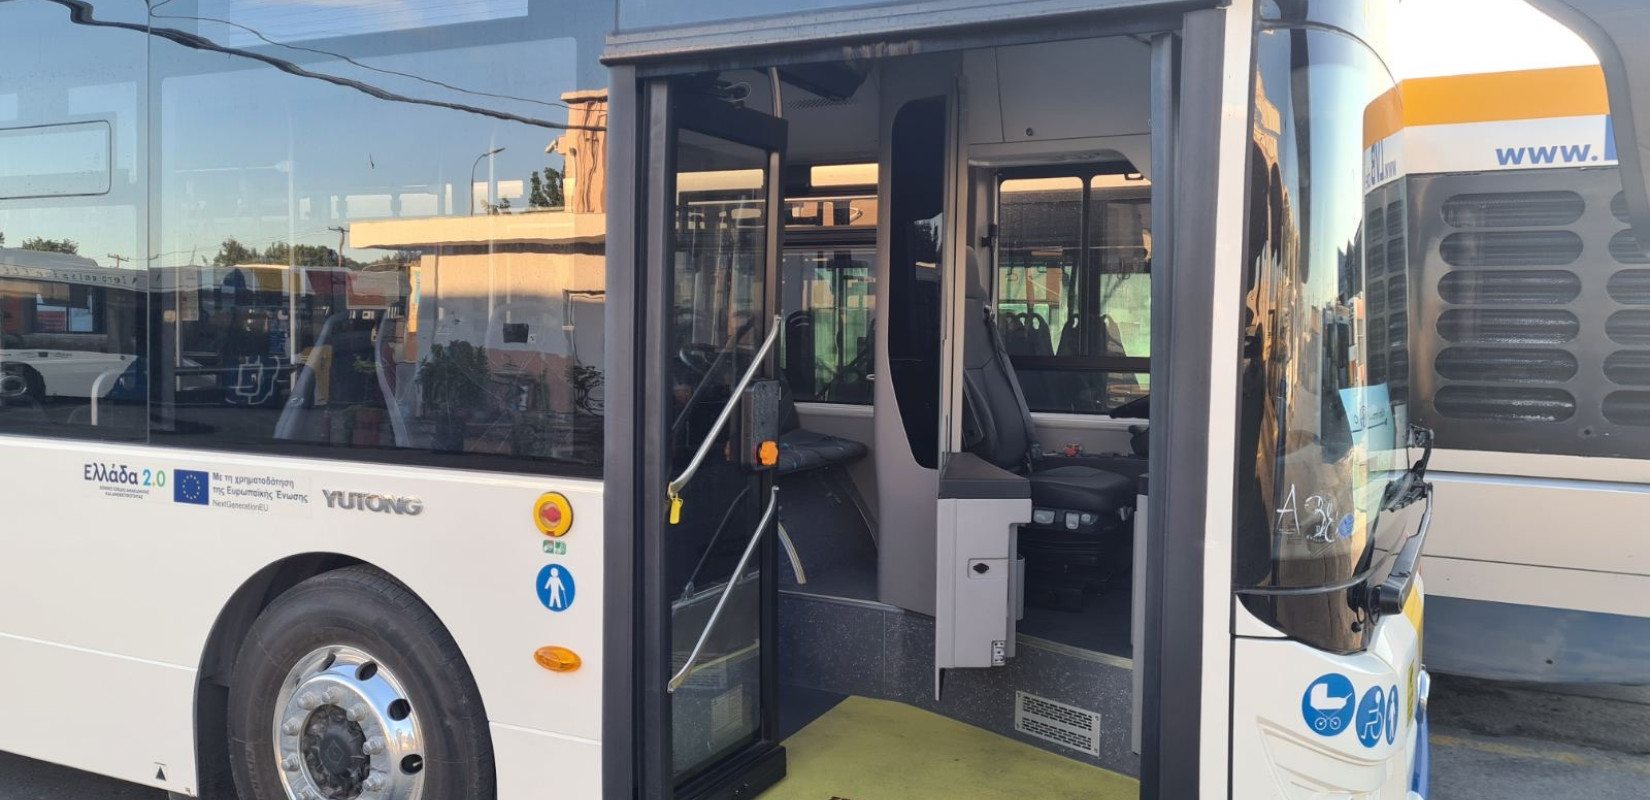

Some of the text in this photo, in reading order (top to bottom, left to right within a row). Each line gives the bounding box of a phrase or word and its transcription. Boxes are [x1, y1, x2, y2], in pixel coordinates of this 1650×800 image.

[1496, 114, 1618, 166] www.
[84, 462, 166, 488] Ελλάδα 2.0
[212, 472, 294, 489] Με τη χρηματοδότηση
[213, 486, 308, 503] της Ευρωπαϊκής Ένωσης
[322, 489, 423, 516] YUTONG
[212, 499, 269, 512] NextGenerationEU
